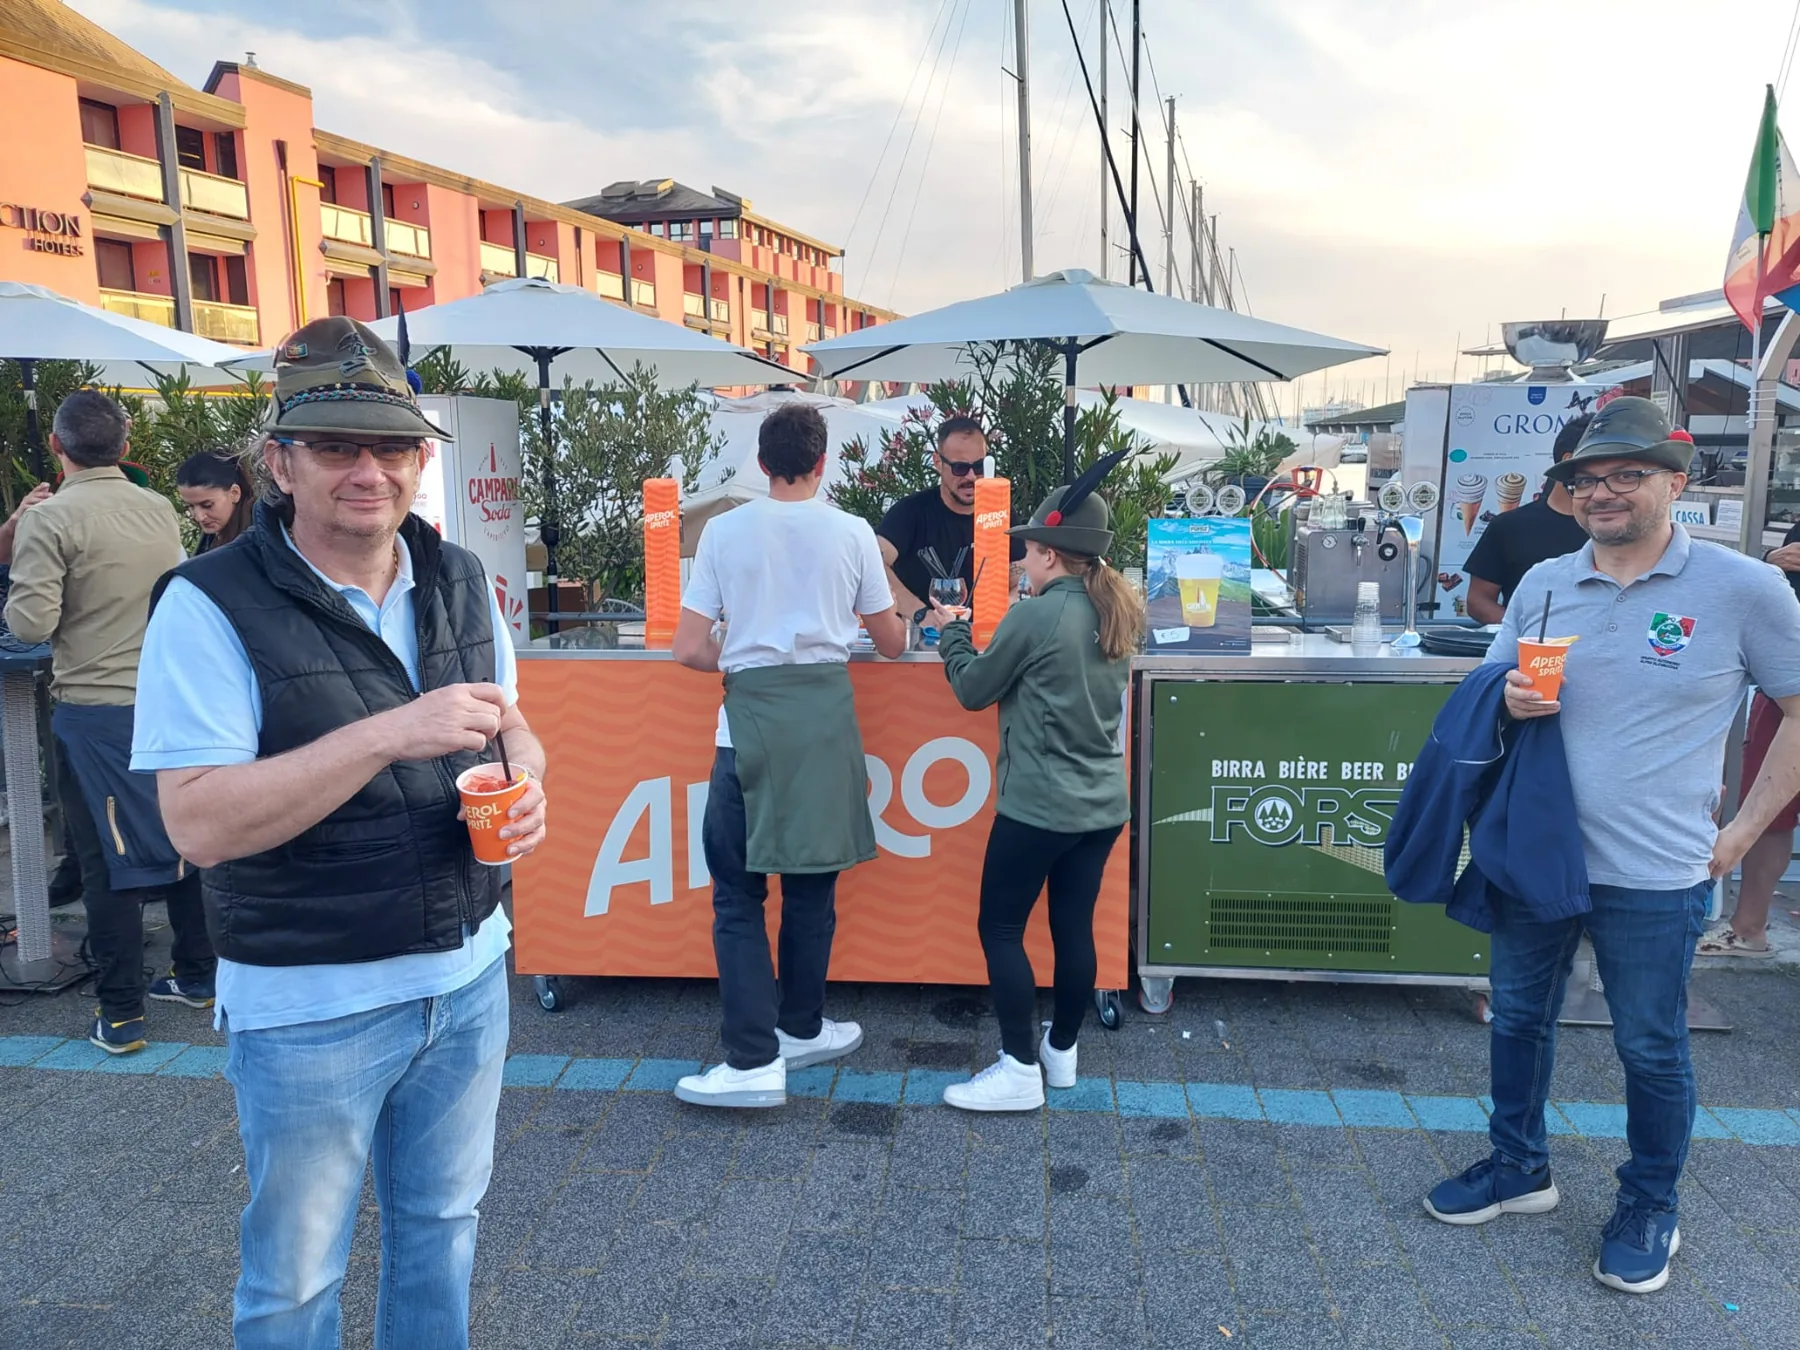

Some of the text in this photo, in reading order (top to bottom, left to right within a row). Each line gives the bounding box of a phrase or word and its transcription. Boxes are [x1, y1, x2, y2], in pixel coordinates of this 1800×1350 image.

[34, 239, 84, 257] HOTELS
[478, 500, 513, 522] Soda
[645, 509, 676, 525] APEROL
[976, 509, 1008, 525] APEROL
[1676, 510, 1704, 525] CASSA
[1212, 760, 1266, 778] BIRRA
[1279, 756, 1328, 780] BIÈRE
[1341, 762, 1384, 780] BEER
